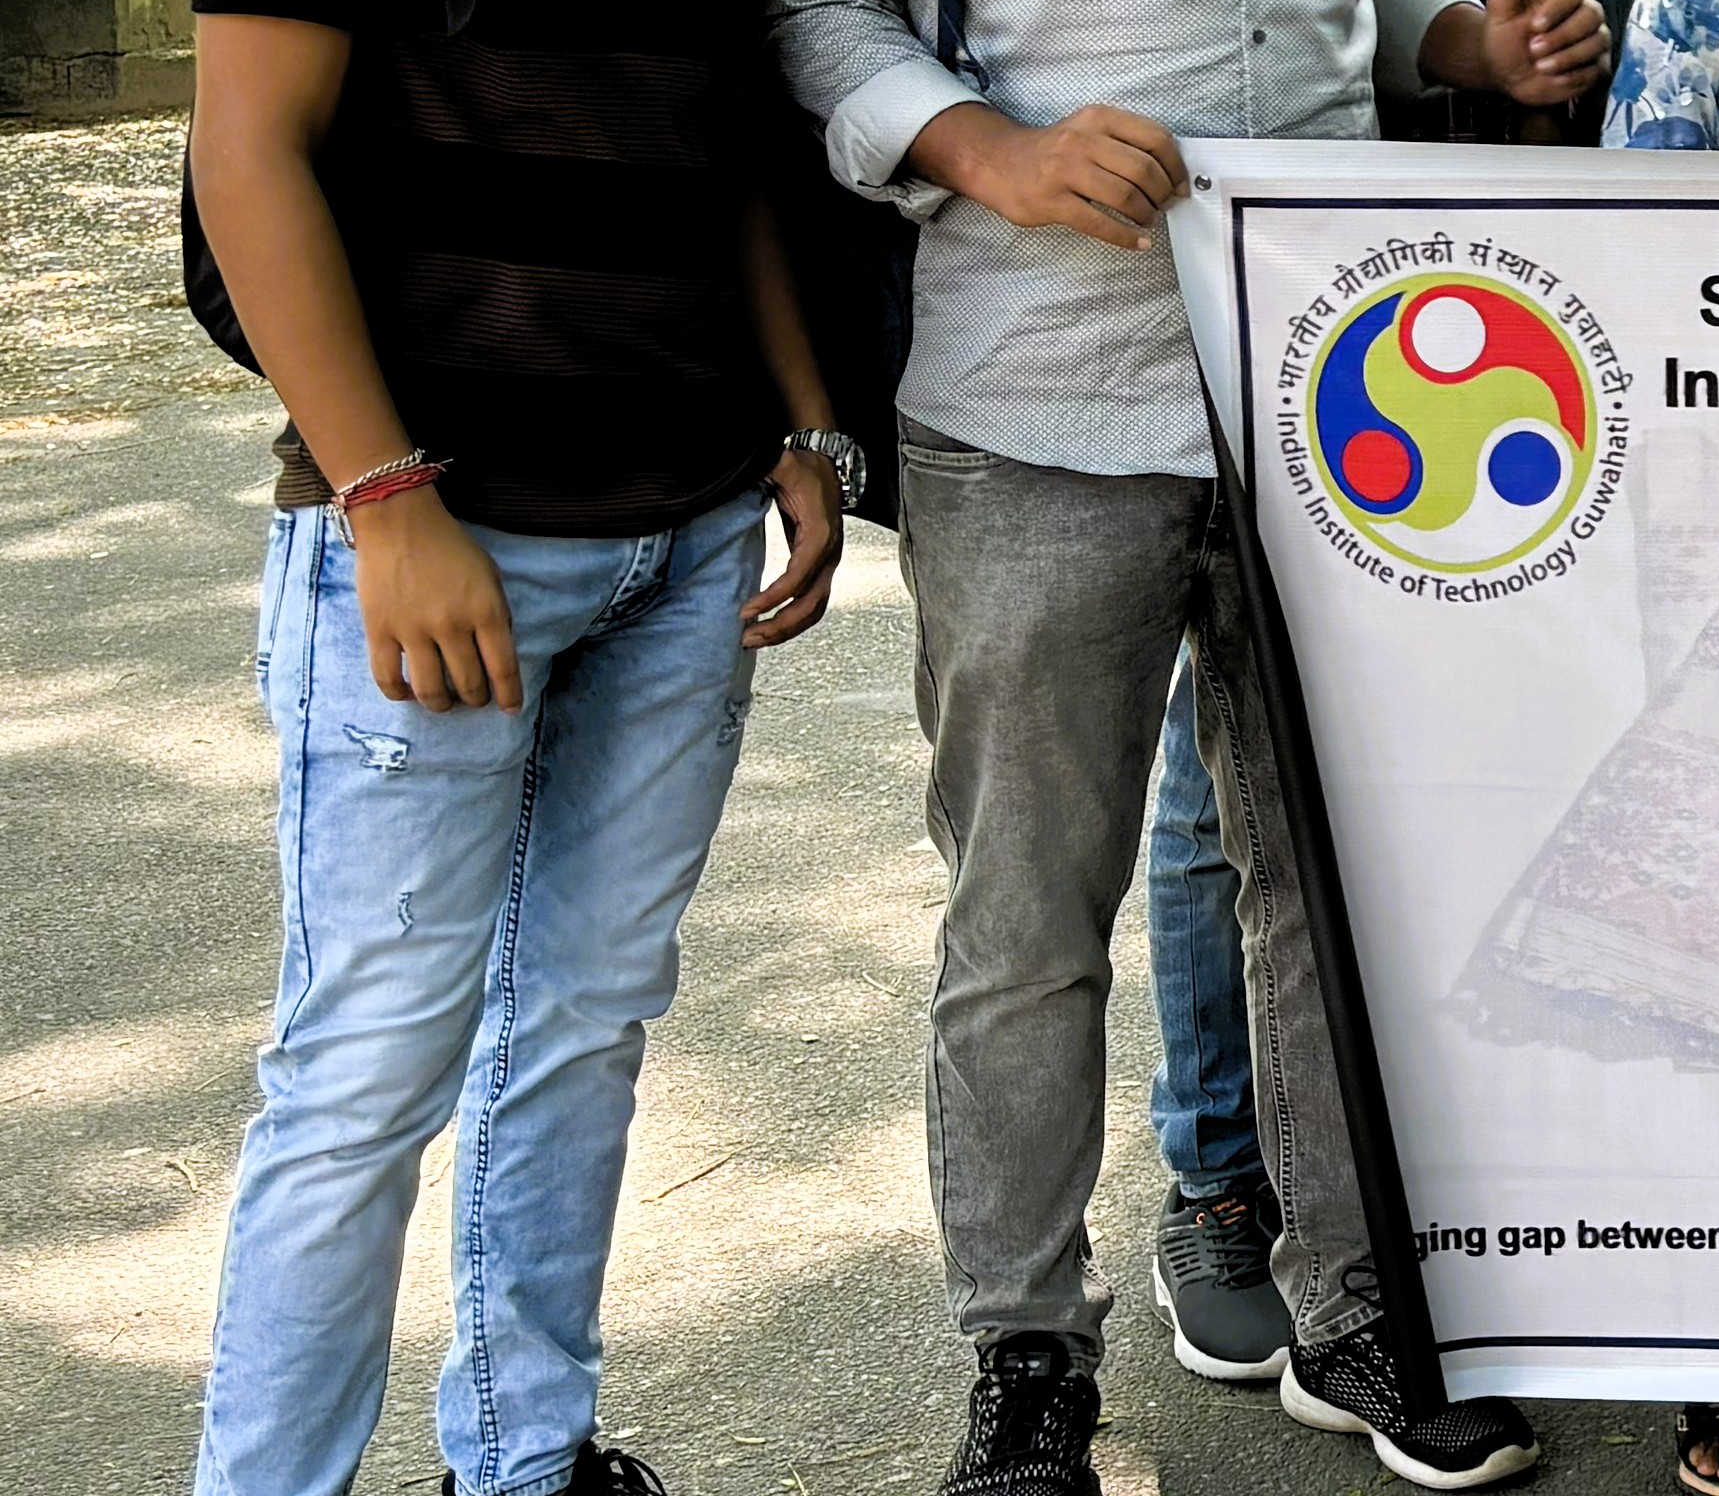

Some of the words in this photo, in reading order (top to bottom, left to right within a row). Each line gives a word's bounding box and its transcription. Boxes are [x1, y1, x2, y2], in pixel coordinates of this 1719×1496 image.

[1278, 295, 1336, 388] भारतीय
[1333, 232, 1454, 299] प्रौद्योगिकी
[1469, 238, 1562, 296] संस्थान
[1558, 294, 1633, 395] गुवाहाटी
[1277, 412, 1313, 496] Indian
[1305, 496, 1395, 584] Institute
[1400, 574, 1428, 595] of
[1430, 540, 1577, 603] Technology
[1571, 417, 1630, 540] Guwahati
[1498, 1227, 1566, 1256] gap
